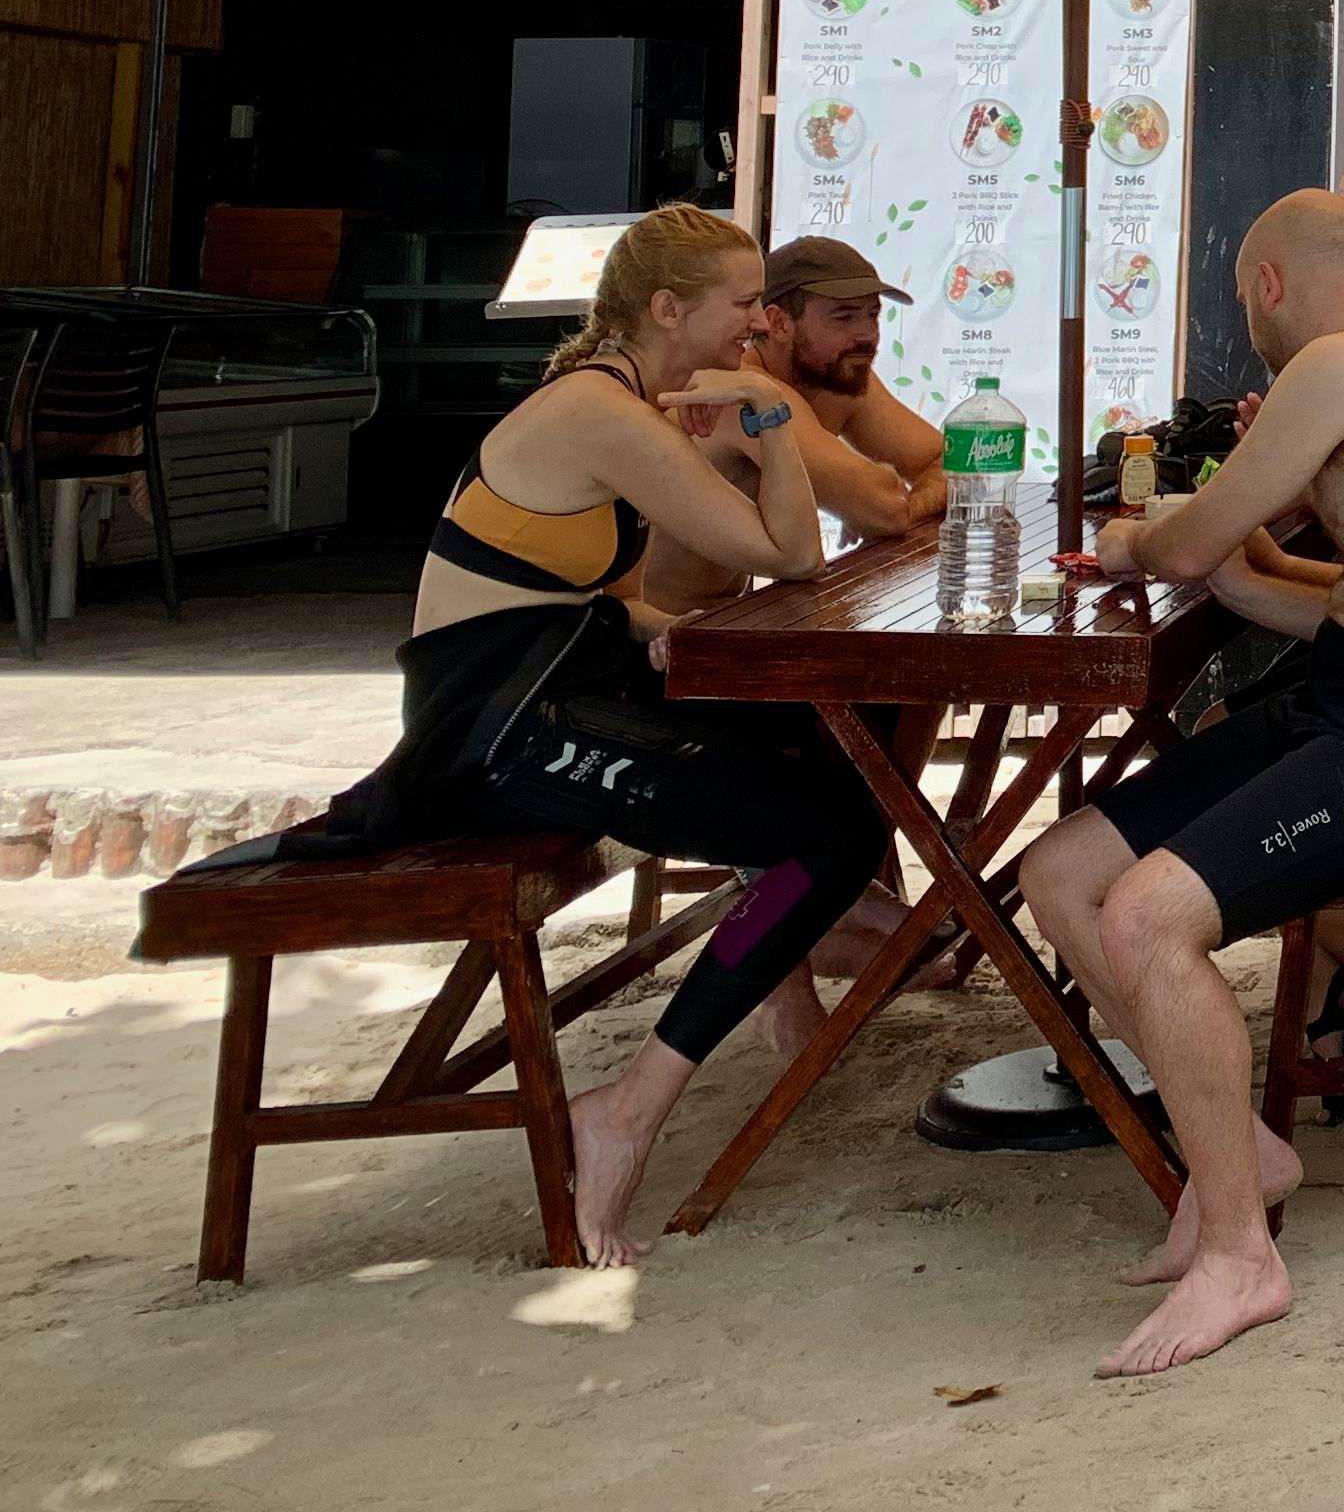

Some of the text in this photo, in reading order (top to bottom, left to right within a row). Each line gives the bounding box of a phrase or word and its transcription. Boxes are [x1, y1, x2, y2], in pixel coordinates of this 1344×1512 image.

[820, 25, 848, 36] SM1
[971, 26, 1002, 36] SM2
[1122, 28, 1153, 39] SM3
[813, 64, 849, 86] 290
[966, 62, 1001, 87] 290
[1118, 64, 1150, 87] 240
[813, 175, 845, 185] SM4
[968, 174, 999, 185] SM5
[1115, 175, 1145, 186] SM6
[810, 201, 844, 225] 240
[965, 221, 994, 243] 200
[1111, 222, 1146, 245] 290
[961, 330, 992, 340] SM8
[1111, 328, 1141, 339] SM9
[1108, 376, 1135, 399] 460
[1261, 808, 1331, 854] Rover 3.2
